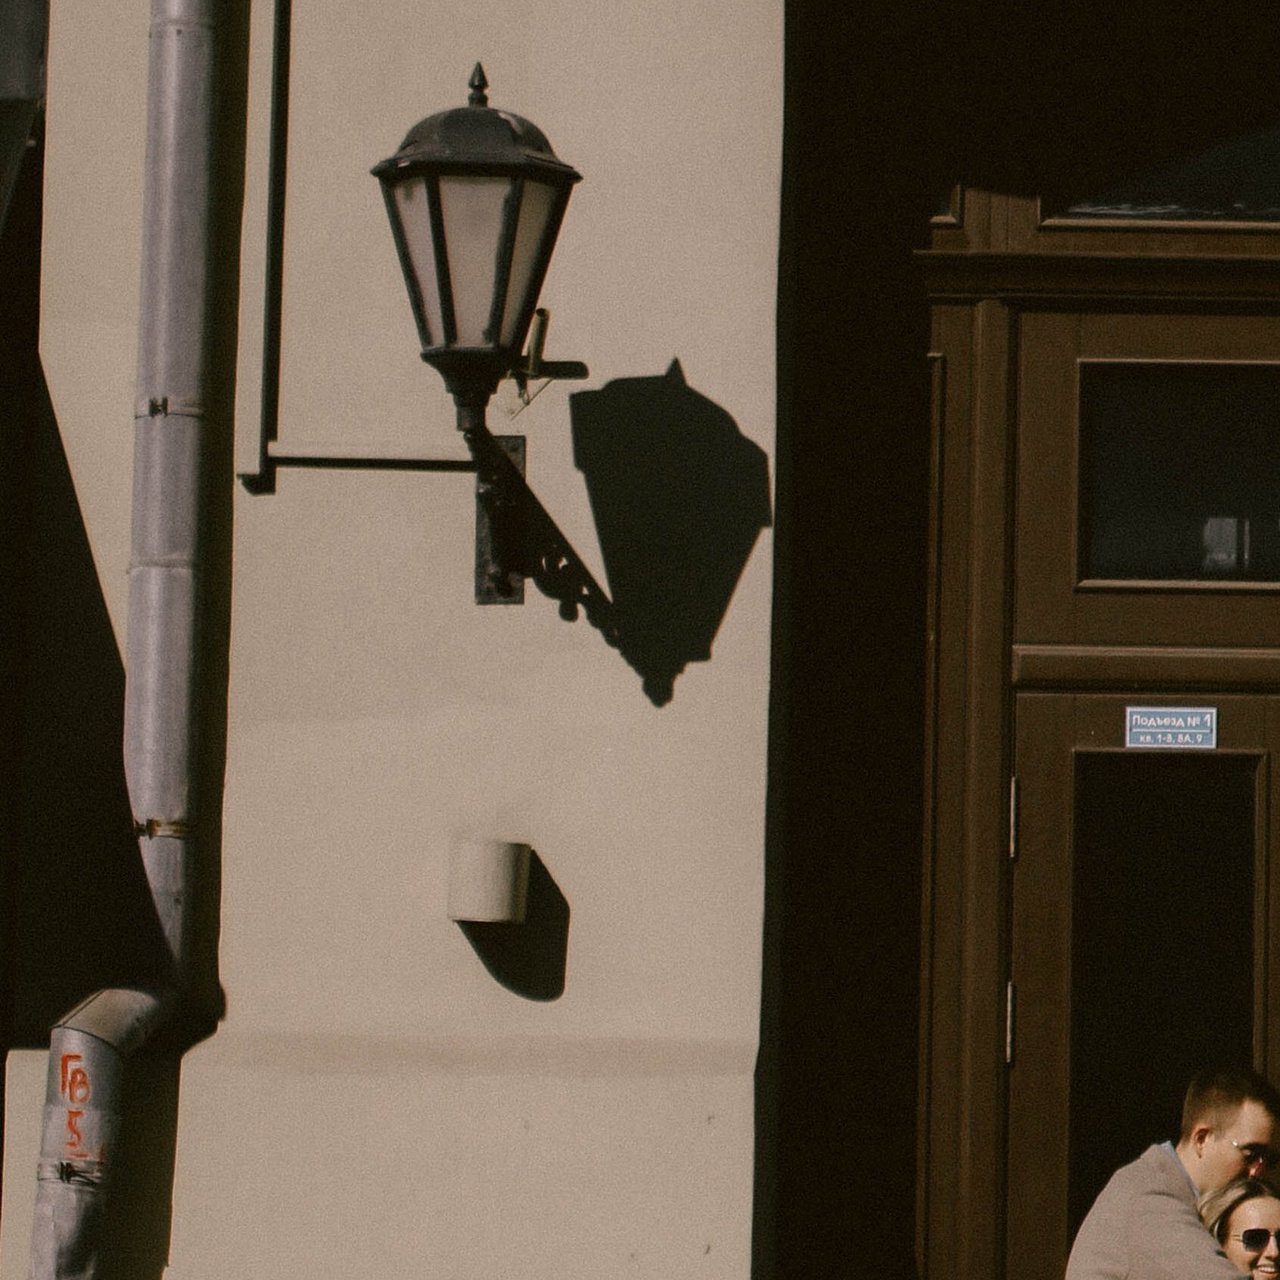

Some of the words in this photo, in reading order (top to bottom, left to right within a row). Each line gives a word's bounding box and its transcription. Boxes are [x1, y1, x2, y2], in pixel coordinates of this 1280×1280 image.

[1132, 714, 1185, 728] Подъезд
[1203, 714, 1211, 727] 1
[1140, 735, 1154, 743] кв.
